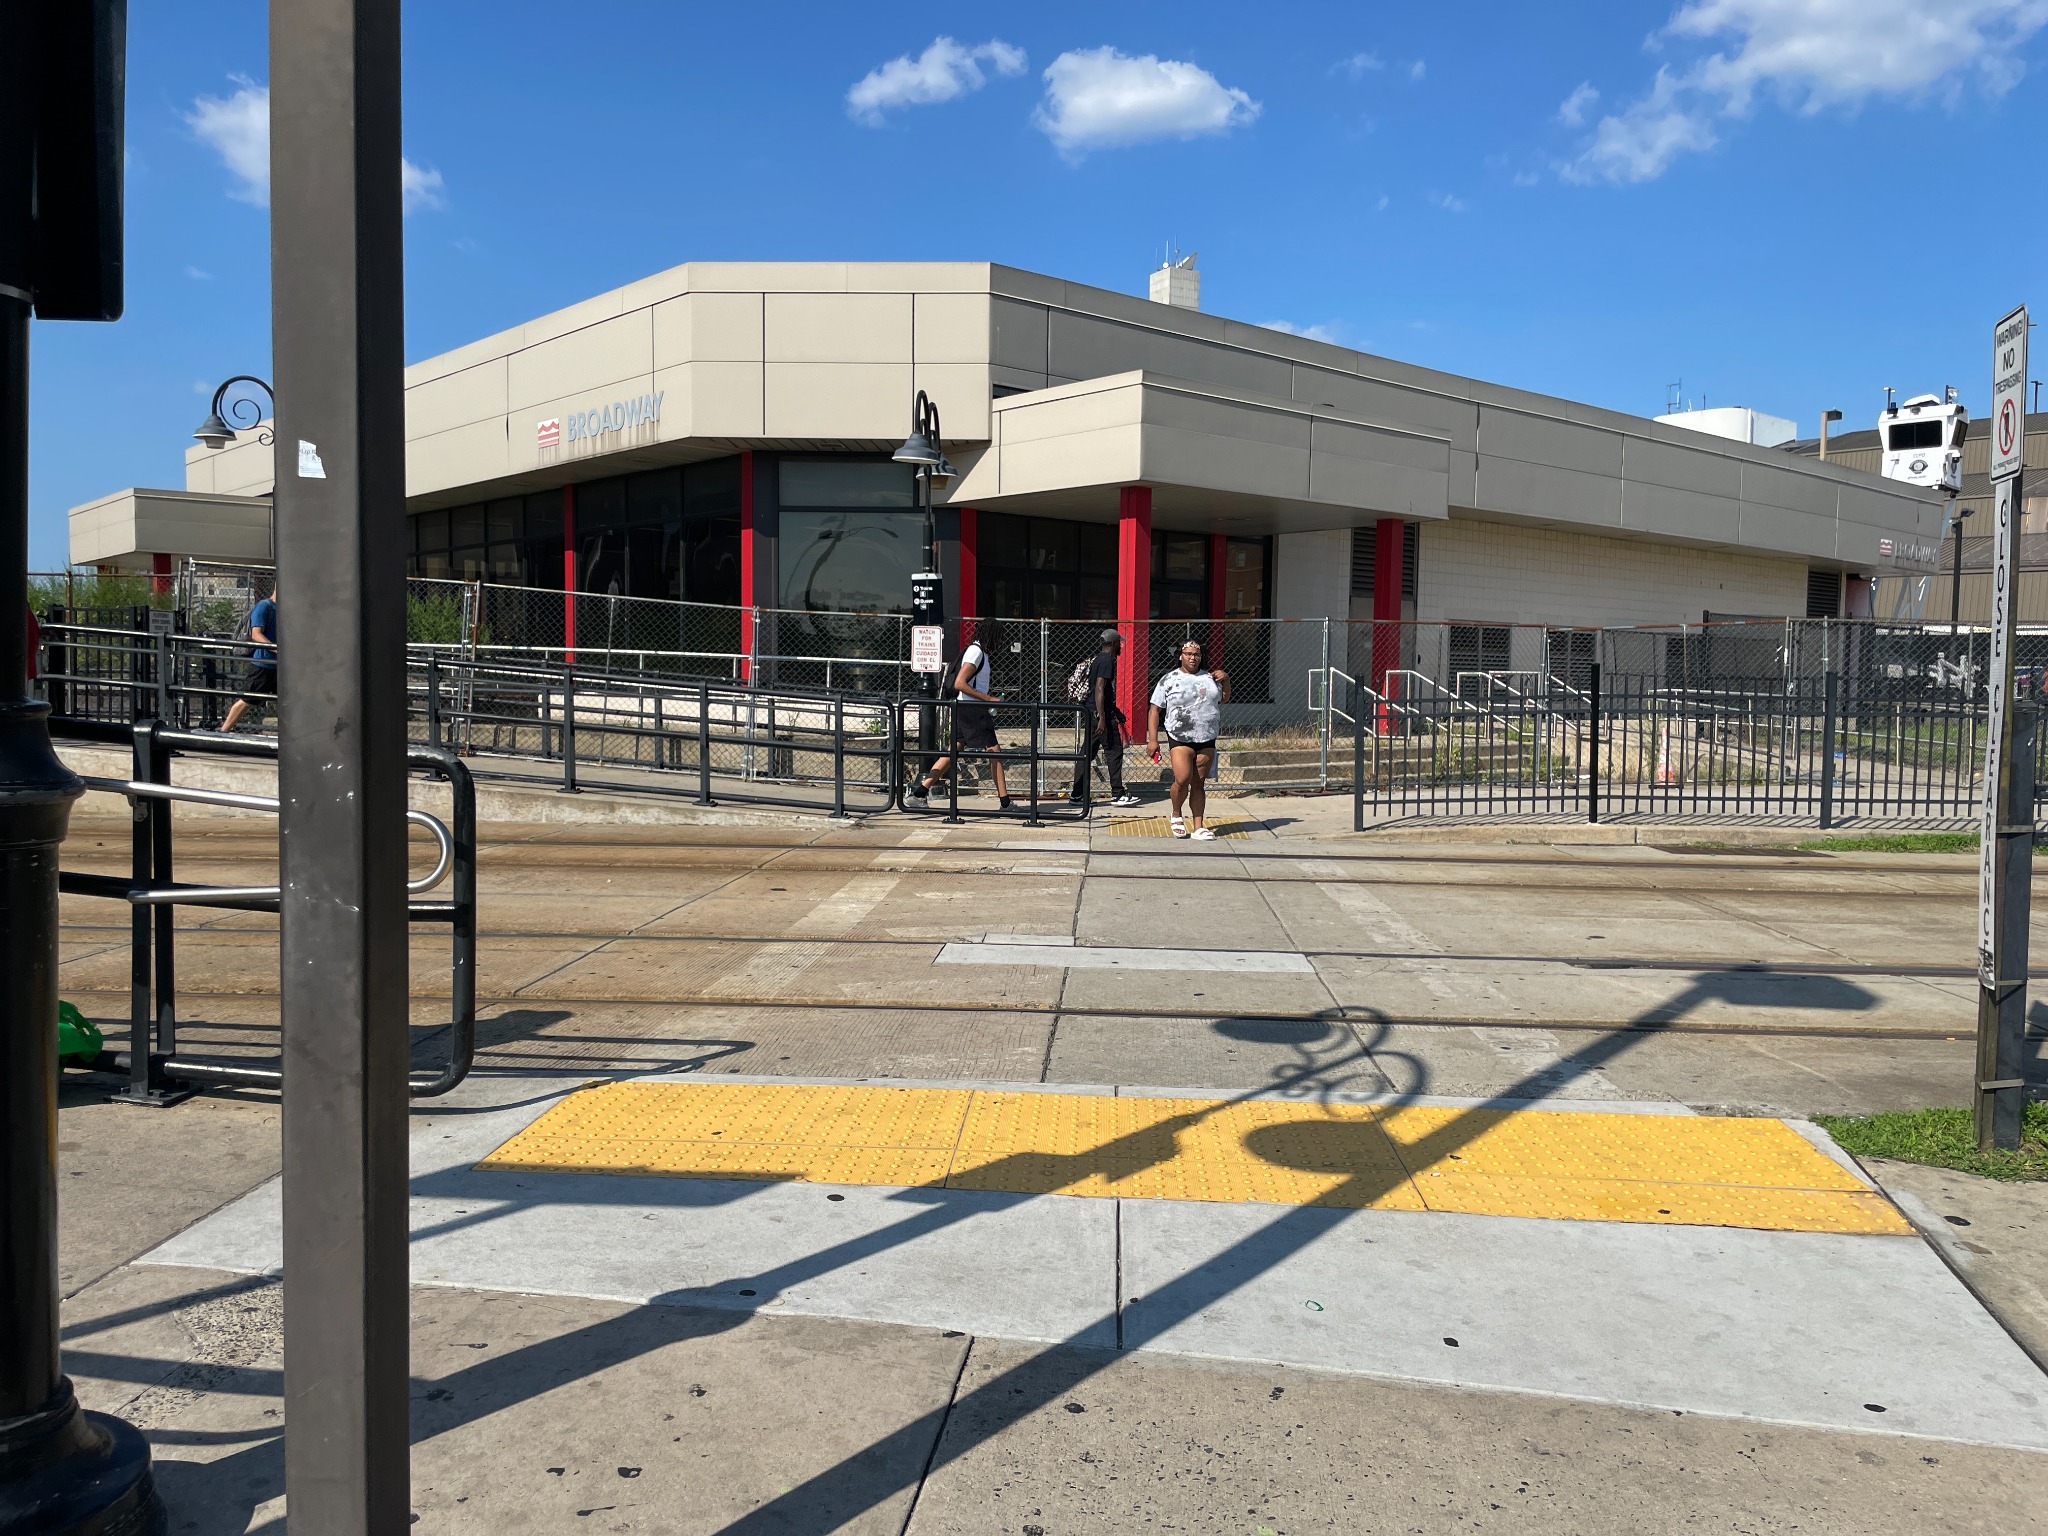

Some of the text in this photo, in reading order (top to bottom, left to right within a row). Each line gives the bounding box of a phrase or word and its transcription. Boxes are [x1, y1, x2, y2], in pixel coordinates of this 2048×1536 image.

[2003, 347, 2015, 372] NO
[567, 390, 665, 442] BROADWAY
[1995, 498, 2007, 658] CLOSE
